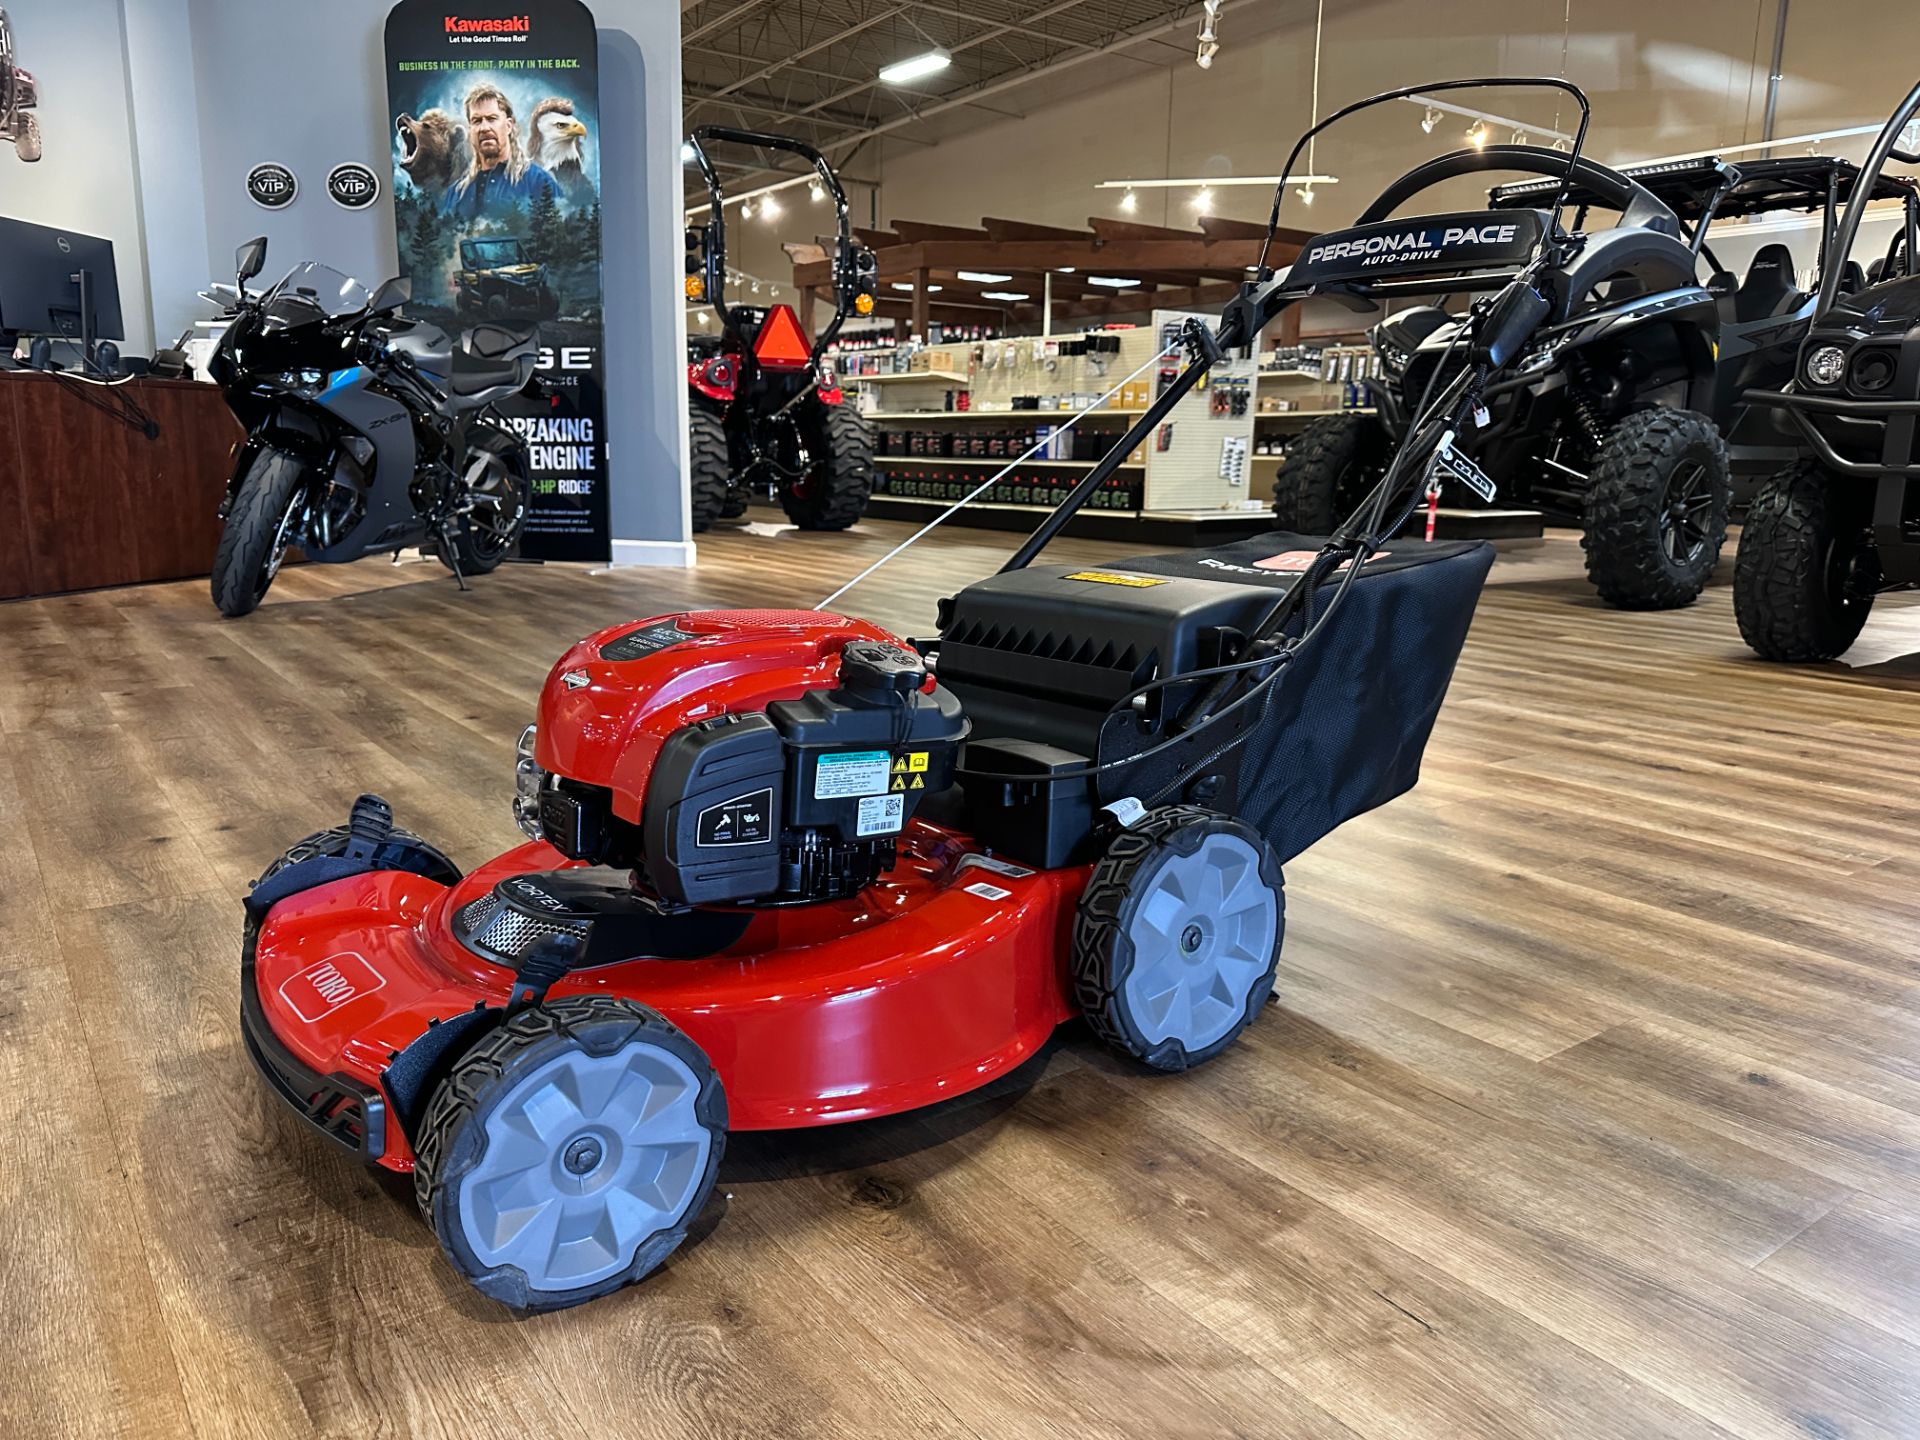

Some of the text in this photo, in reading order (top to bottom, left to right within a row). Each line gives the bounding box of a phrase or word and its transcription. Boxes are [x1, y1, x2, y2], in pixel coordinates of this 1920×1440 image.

[444, 16, 530, 32] Kawasaki
[473, 35, 491, 43] Good
[492, 35, 512, 43] Times
[512, 34, 528, 42] Roll
[399, 58, 581, 71] BUSINESS IN THE FRONT. PARTY IN THE BACK.
[257, 181, 284, 193] VIP
[338, 181, 366, 193] VIP
[1308, 224, 1518, 265] PERSONAL PACE
[1361, 249, 1442, 267] AUTO-DRIVE
[529, 445, 595, 471] ENGINE
[558, 479, 592, 495] RIDGE
[511, 878, 569, 911] VORTEX
[305, 962, 356, 1004] TORO
